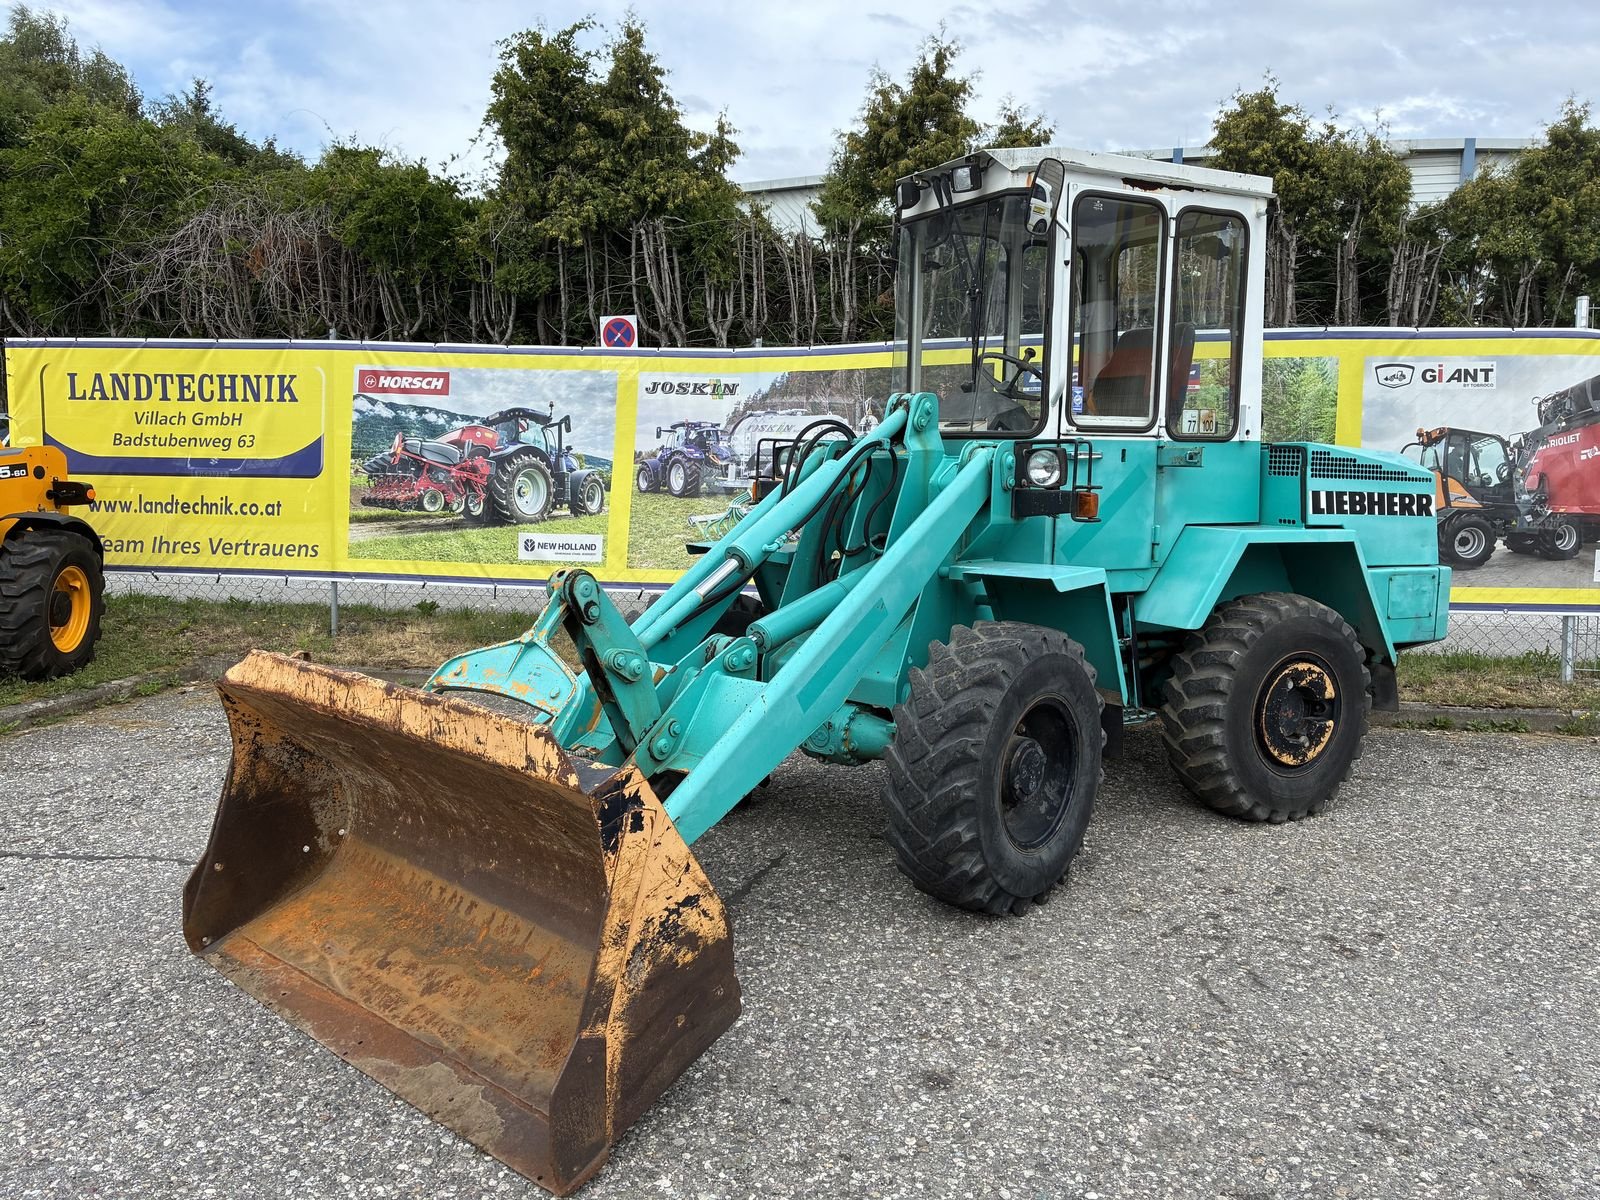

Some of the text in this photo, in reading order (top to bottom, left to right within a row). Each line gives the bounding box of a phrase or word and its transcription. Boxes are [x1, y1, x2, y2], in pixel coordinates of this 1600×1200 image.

[67, 372, 299, 402] LANDTECHNIK
[378, 375, 444, 390] HORSCH
[645, 381, 739, 396] JOSKIN
[134, 411, 243, 427] Villach GmbH
[1187, 419, 1196, 432] 77
[1203, 419, 1214, 432] 100
[112, 432, 256, 451] Badstubenweg 63
[89, 494, 282, 516] www.landtechnik.co.at
[1311, 490, 1433, 517] LIEBHERR
[151, 536, 201, 554] Ihres
[208, 537, 319, 558] Vertrauens
[537, 541, 597, 551] NEW HOLLAND
